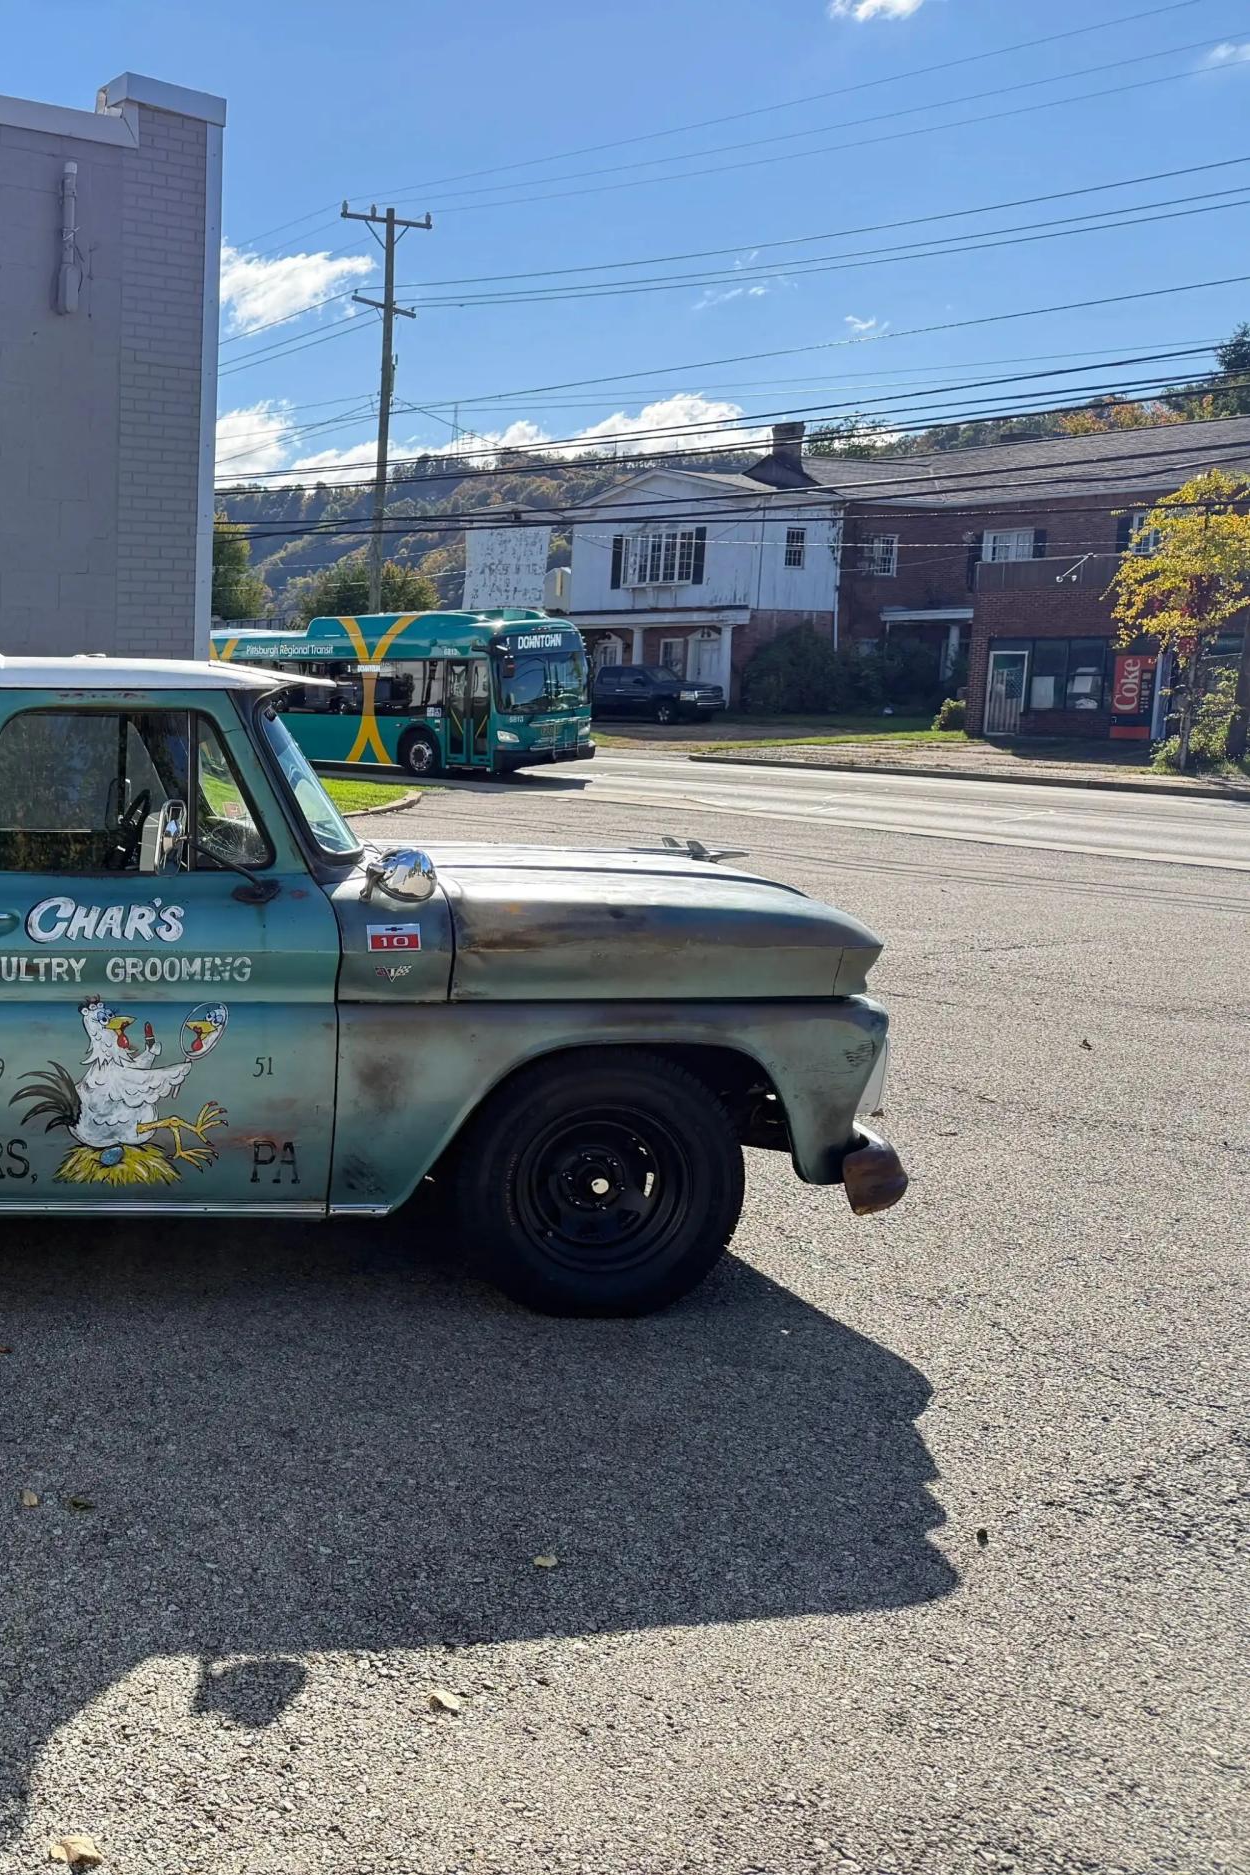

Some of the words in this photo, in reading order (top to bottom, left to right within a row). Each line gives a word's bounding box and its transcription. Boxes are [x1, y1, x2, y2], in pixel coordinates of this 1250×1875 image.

[246, 644, 279, 657] Pittsburgh
[279, 644, 310, 657] Regional
[311, 644, 334, 655] Transit
[517, 633, 562, 650] DOWNTOWN
[1113, 658, 1141, 711] Coke
[26, 896, 185, 943] CHAR'S
[380, 936, 409, 947] 10
[105, 955, 253, 984] GROOMING
[252, 1056, 274, 1078] 51
[250, 1140, 301, 1184] PA
